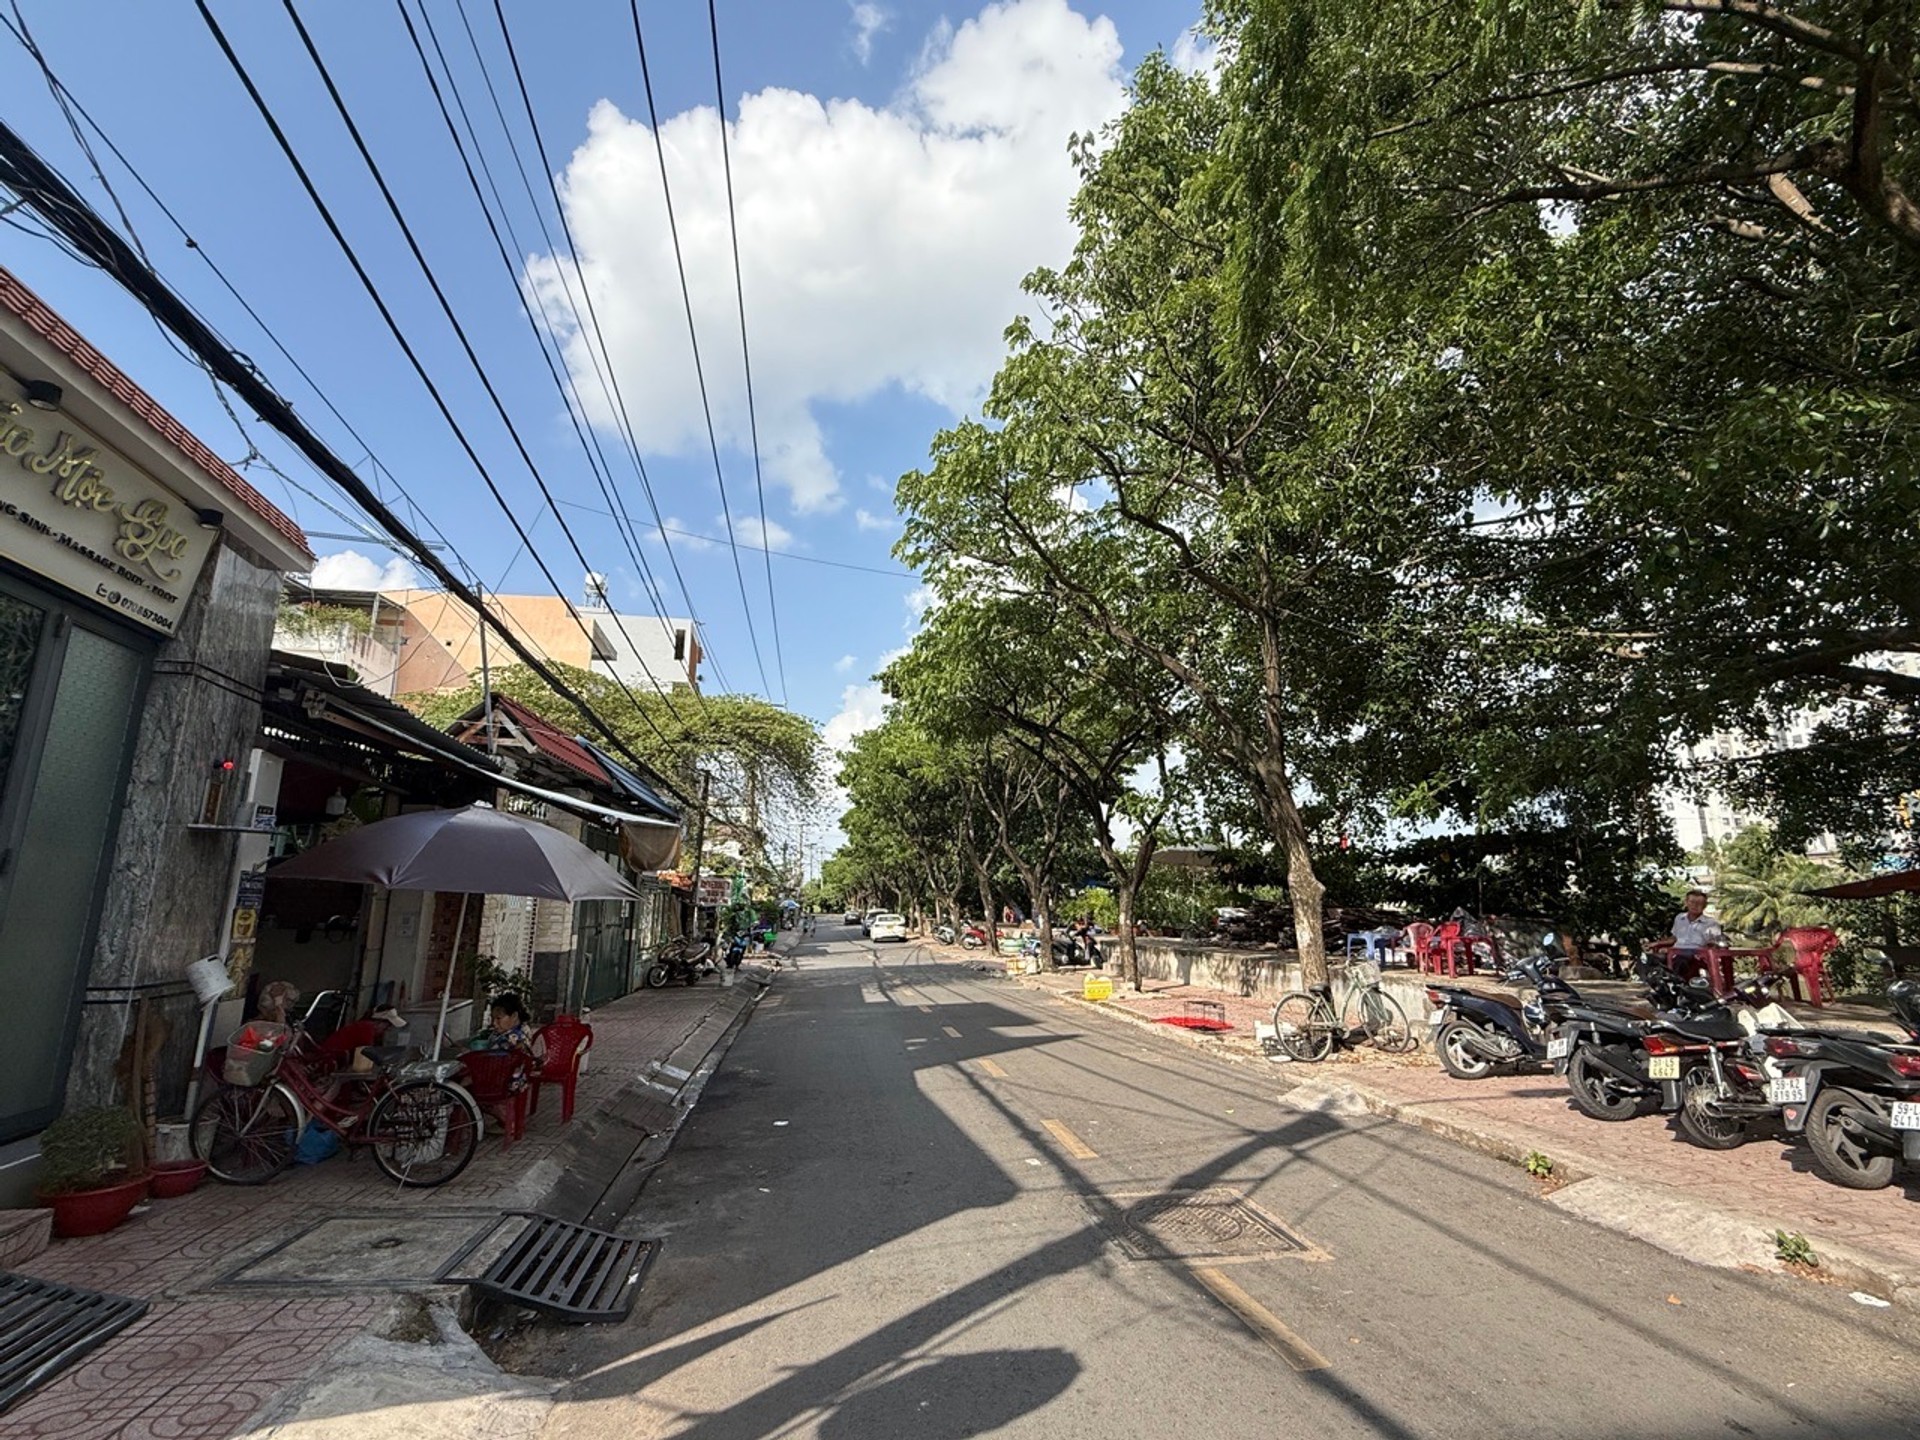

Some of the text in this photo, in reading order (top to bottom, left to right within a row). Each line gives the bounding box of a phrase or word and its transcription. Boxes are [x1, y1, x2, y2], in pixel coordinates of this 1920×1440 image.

[57, 532, 117, 571] MASSAGE
[116, 565, 146, 588] BODY
[152, 585, 180, 604] FOOT
[119, 500, 188, 582] Spa
